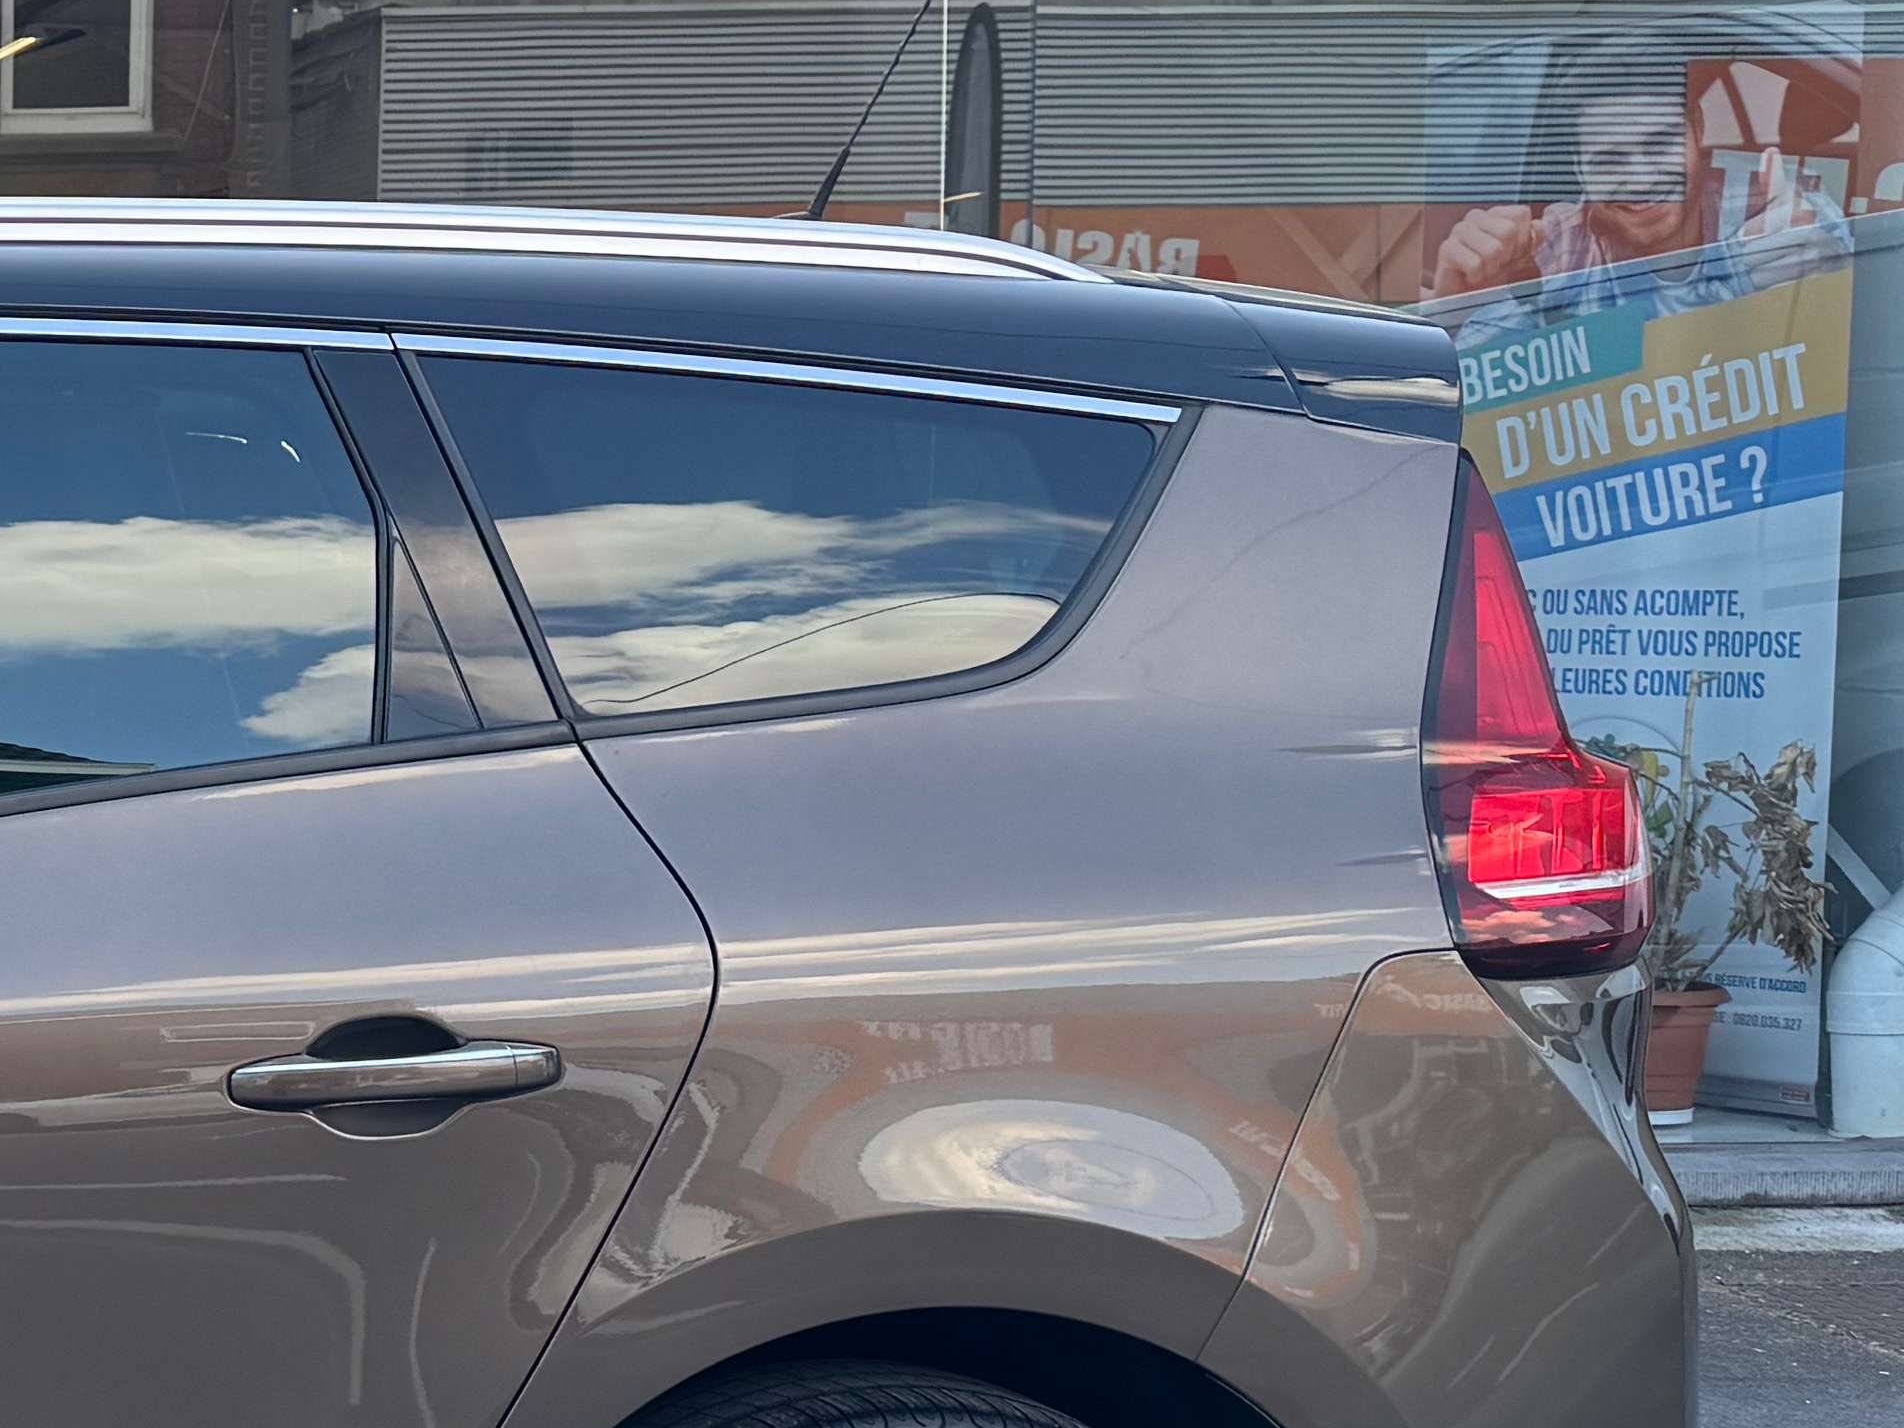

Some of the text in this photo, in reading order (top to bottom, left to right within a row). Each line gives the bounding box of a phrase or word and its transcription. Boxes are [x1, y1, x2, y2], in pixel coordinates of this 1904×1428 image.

[1459, 325, 1592, 406] BESOIN
[1496, 342, 1807, 480] D'UN CRÉDIT
[1536, 453, 1733, 548] VOITURE
[1542, 589, 1569, 615] OU
[1573, 588, 1628, 616] SANS
[1634, 589, 1745, 620] ACOMPTE,
[1546, 623, 1802, 659] DU PRÊT VOUS PROPOSE
